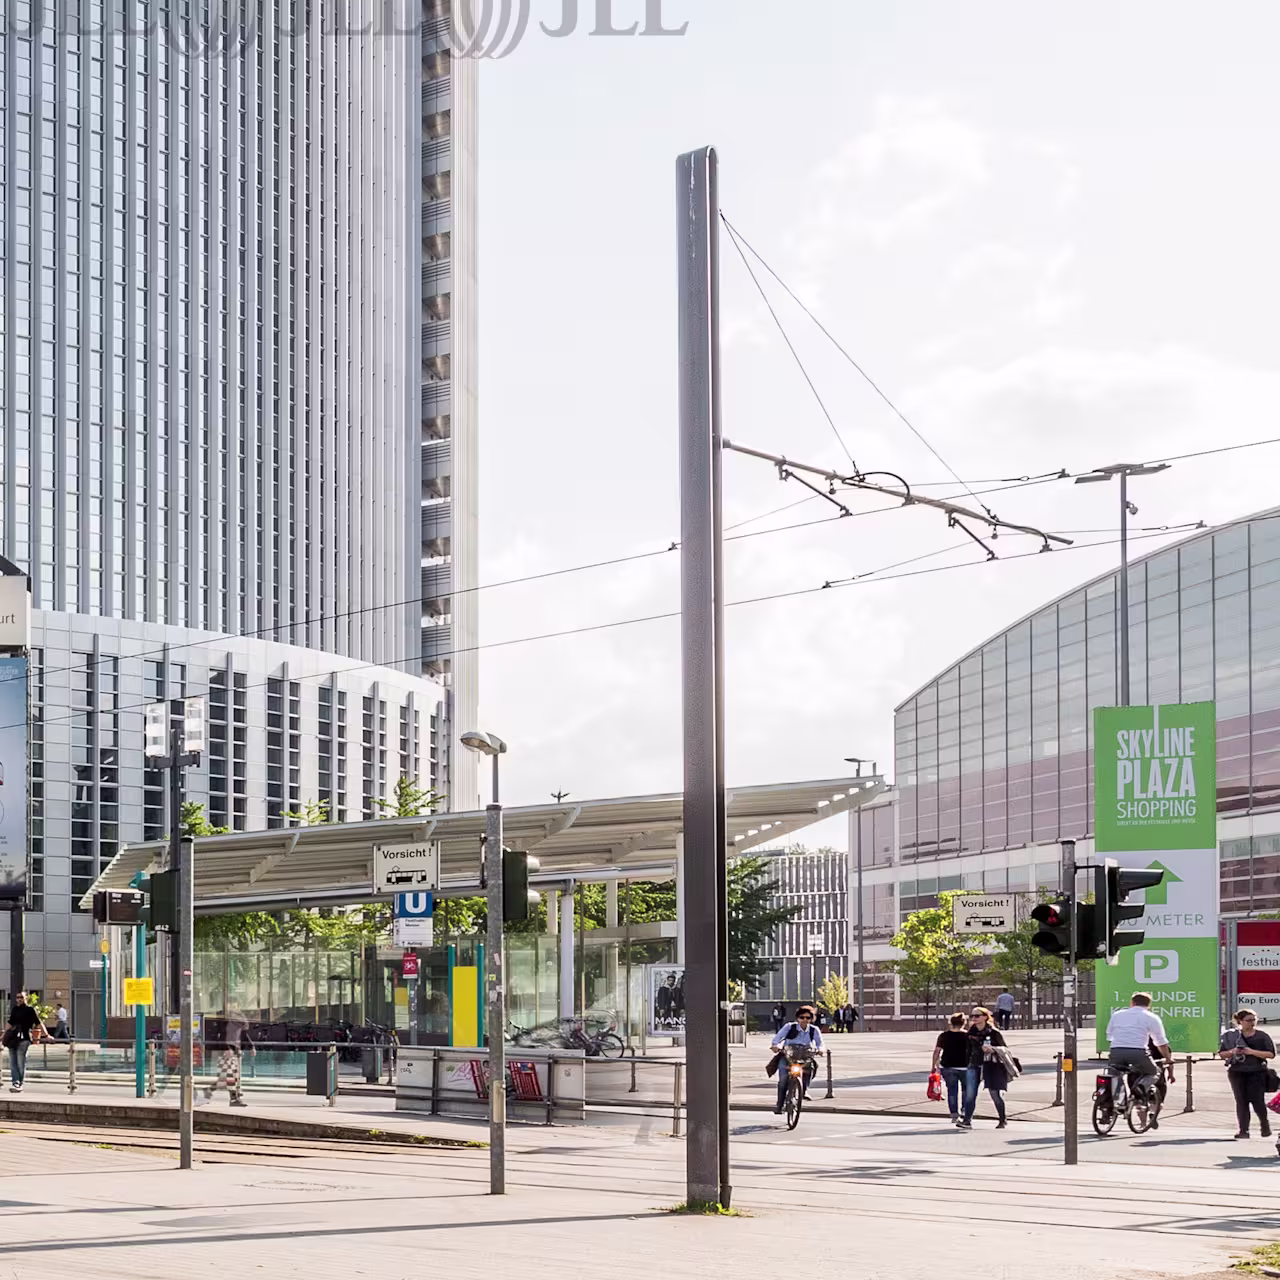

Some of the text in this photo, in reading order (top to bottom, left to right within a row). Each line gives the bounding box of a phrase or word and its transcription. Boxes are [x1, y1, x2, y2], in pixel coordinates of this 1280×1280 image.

[1117, 705, 1196, 759] SKYLINE
[1117, 757, 1196, 800] PLAZA
[1117, 799, 1197, 819] SHOPPING
[405, 892, 427, 914] U
[1146, 914, 1204, 926] METER
[1144, 955, 1169, 978] P
[1114, 991, 1197, 1002] 1. UNDE
[1238, 996, 1256, 1005] Kap
